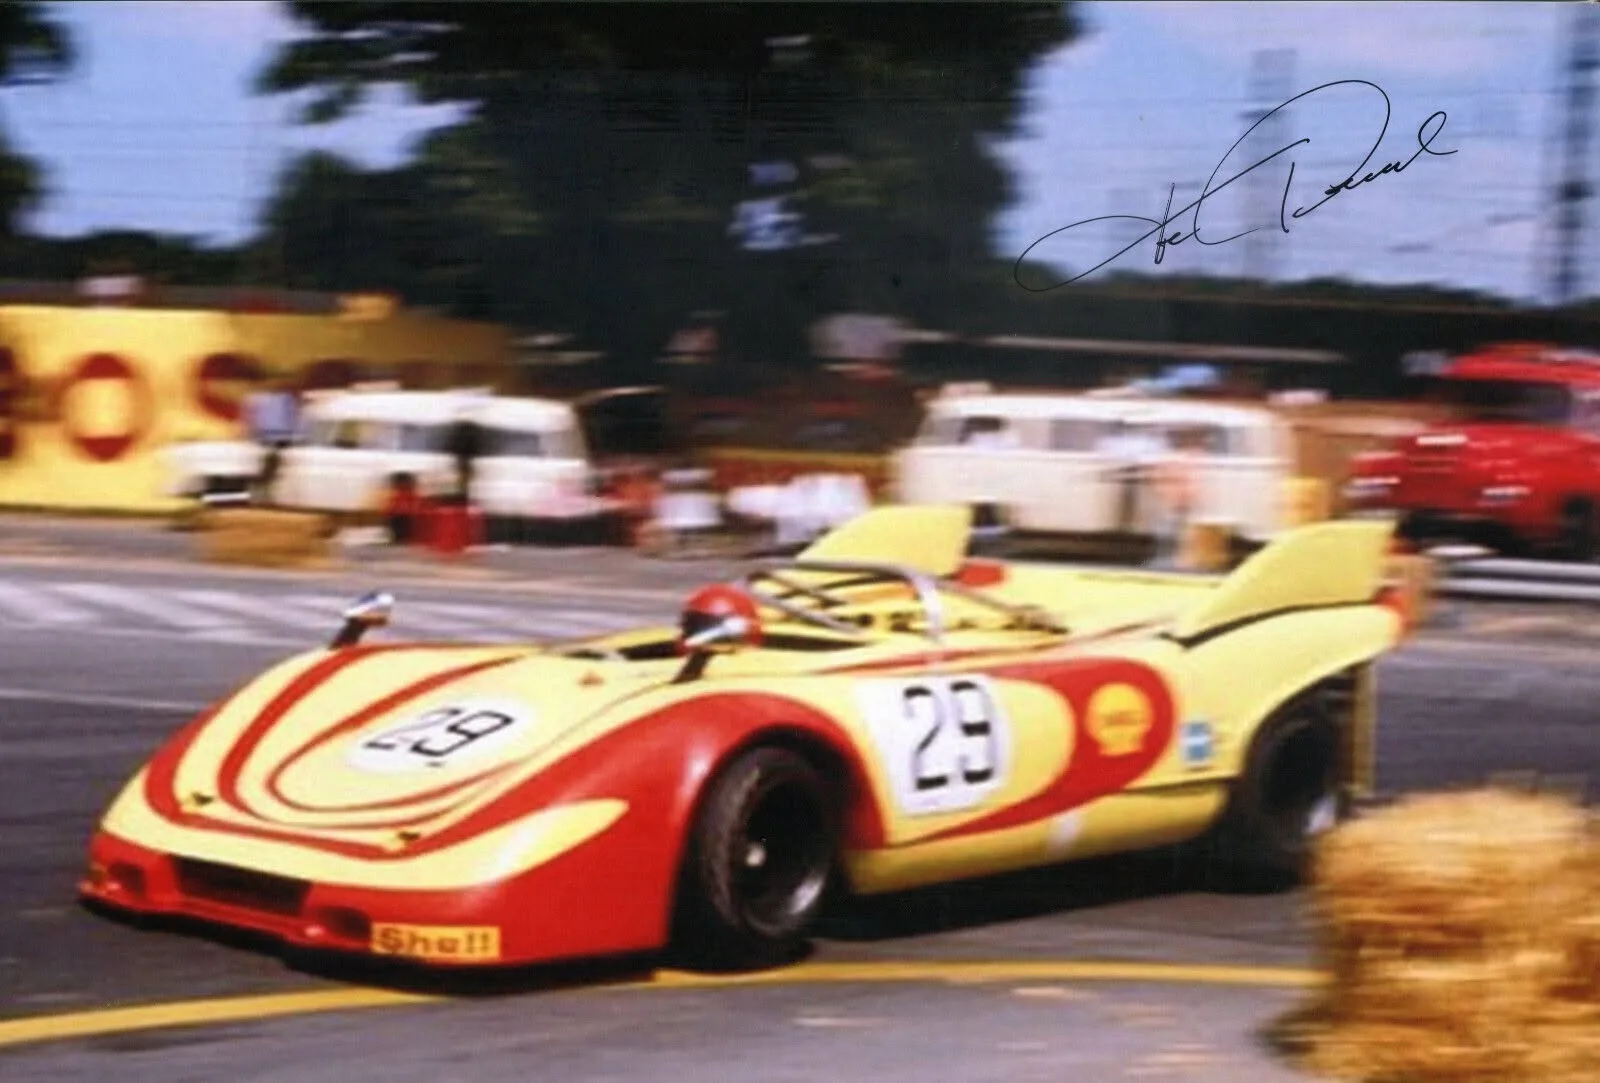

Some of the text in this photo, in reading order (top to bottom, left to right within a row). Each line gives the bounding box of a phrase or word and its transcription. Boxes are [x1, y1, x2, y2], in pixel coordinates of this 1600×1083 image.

[363, 708, 514, 757] 29
[903, 681, 997, 791] 29
[379, 926, 491, 954] Shell
